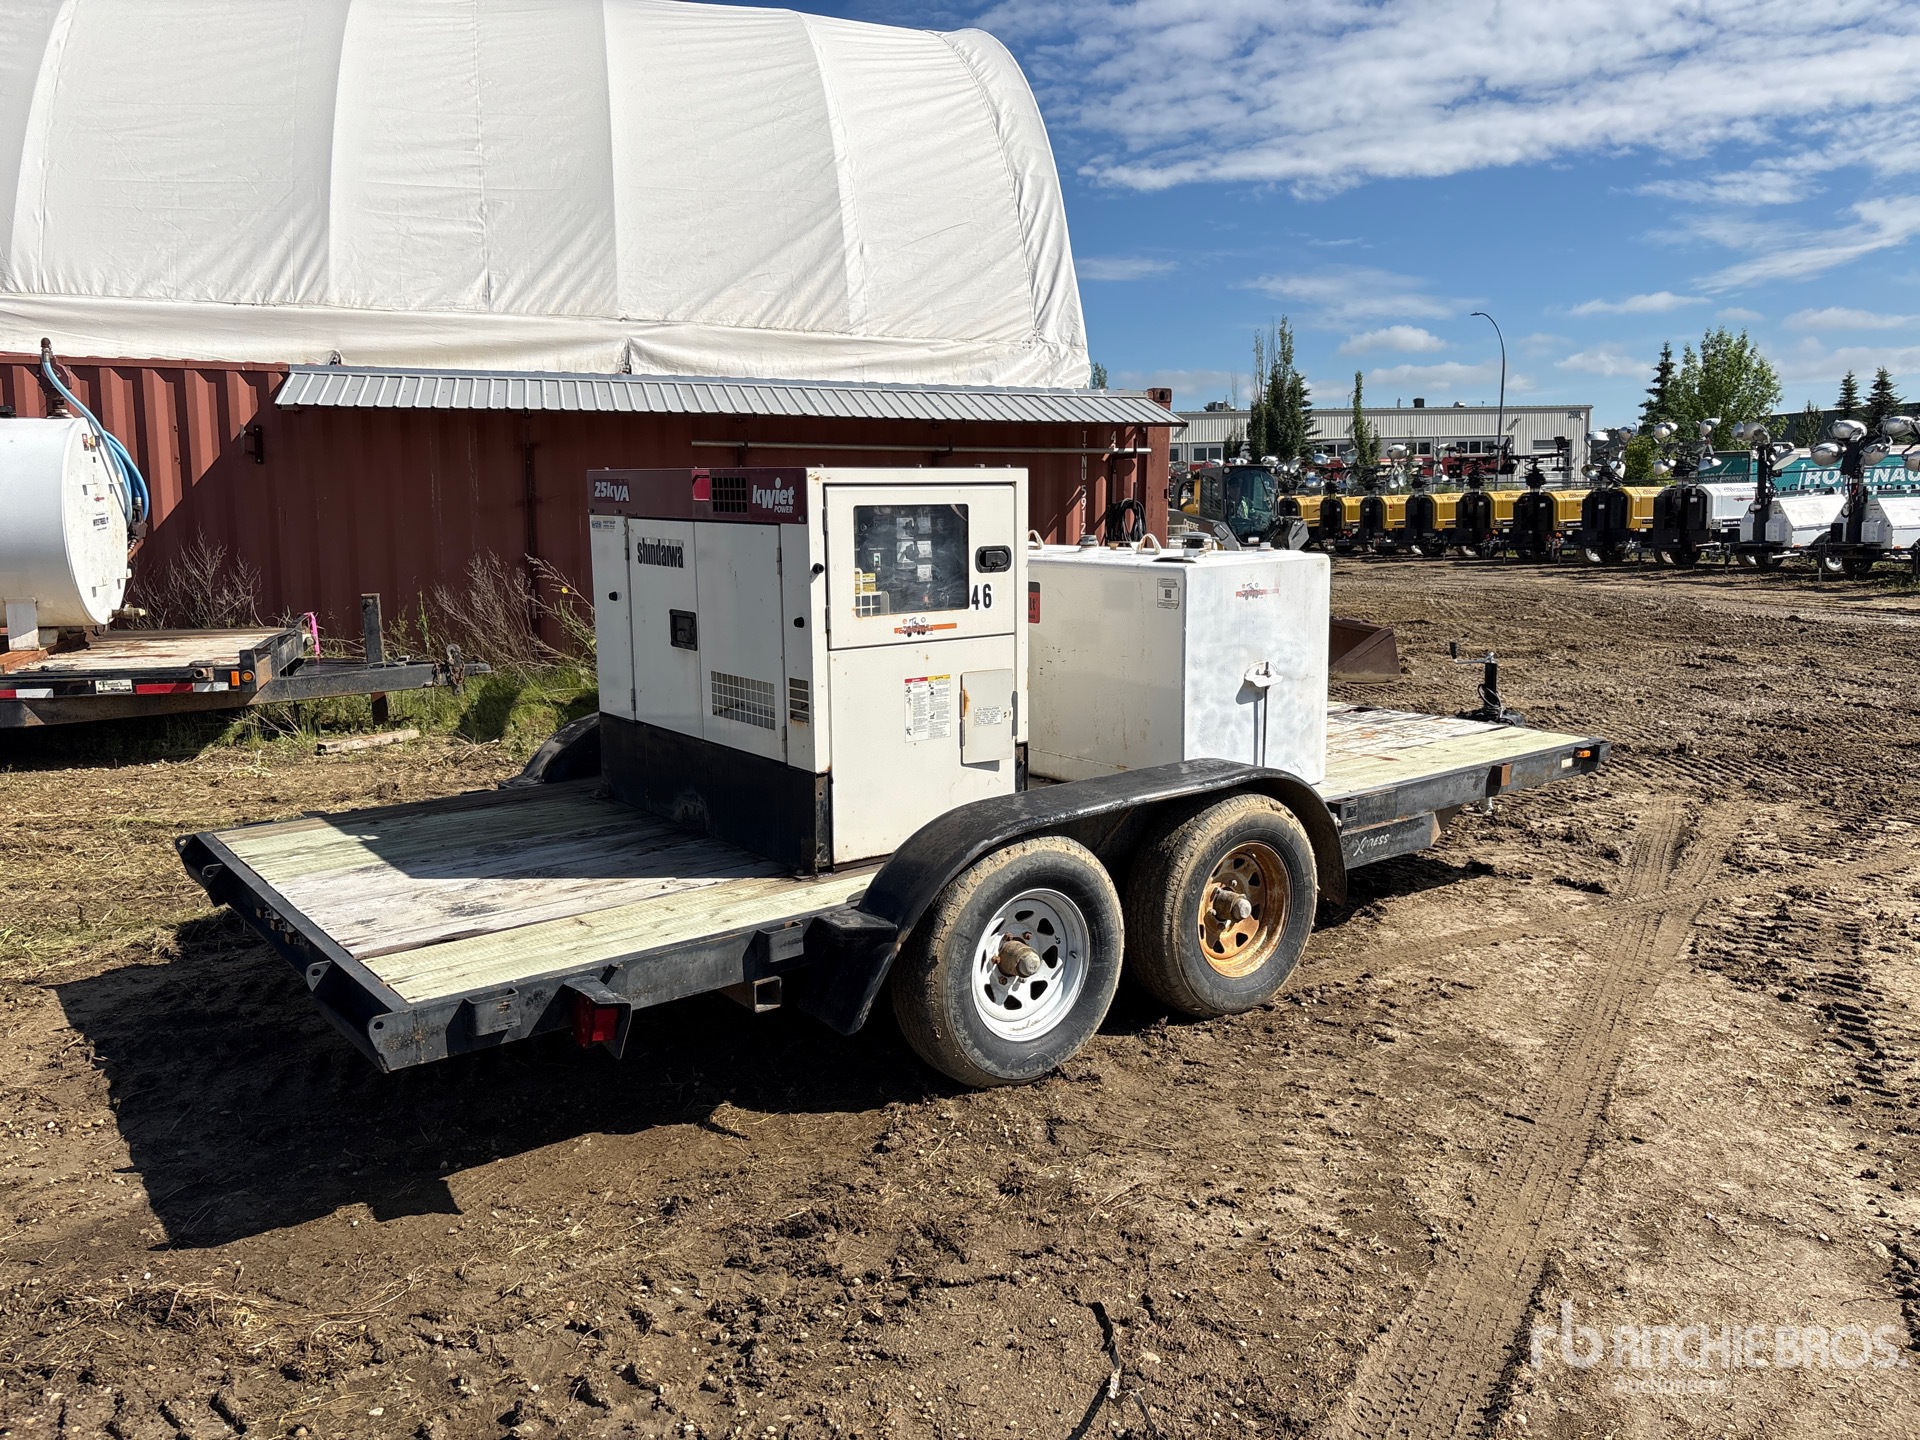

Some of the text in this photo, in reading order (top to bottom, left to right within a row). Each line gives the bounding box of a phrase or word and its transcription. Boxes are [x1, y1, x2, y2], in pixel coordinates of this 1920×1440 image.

[1804, 466, 1920, 486] ROENAU
[594, 481, 630, 502] 25kVA
[752, 477, 795, 509] kwiet
[773, 505, 794, 514] POWER
[637, 538, 684, 568] shindaiwa
[971, 583, 992, 611] 46
